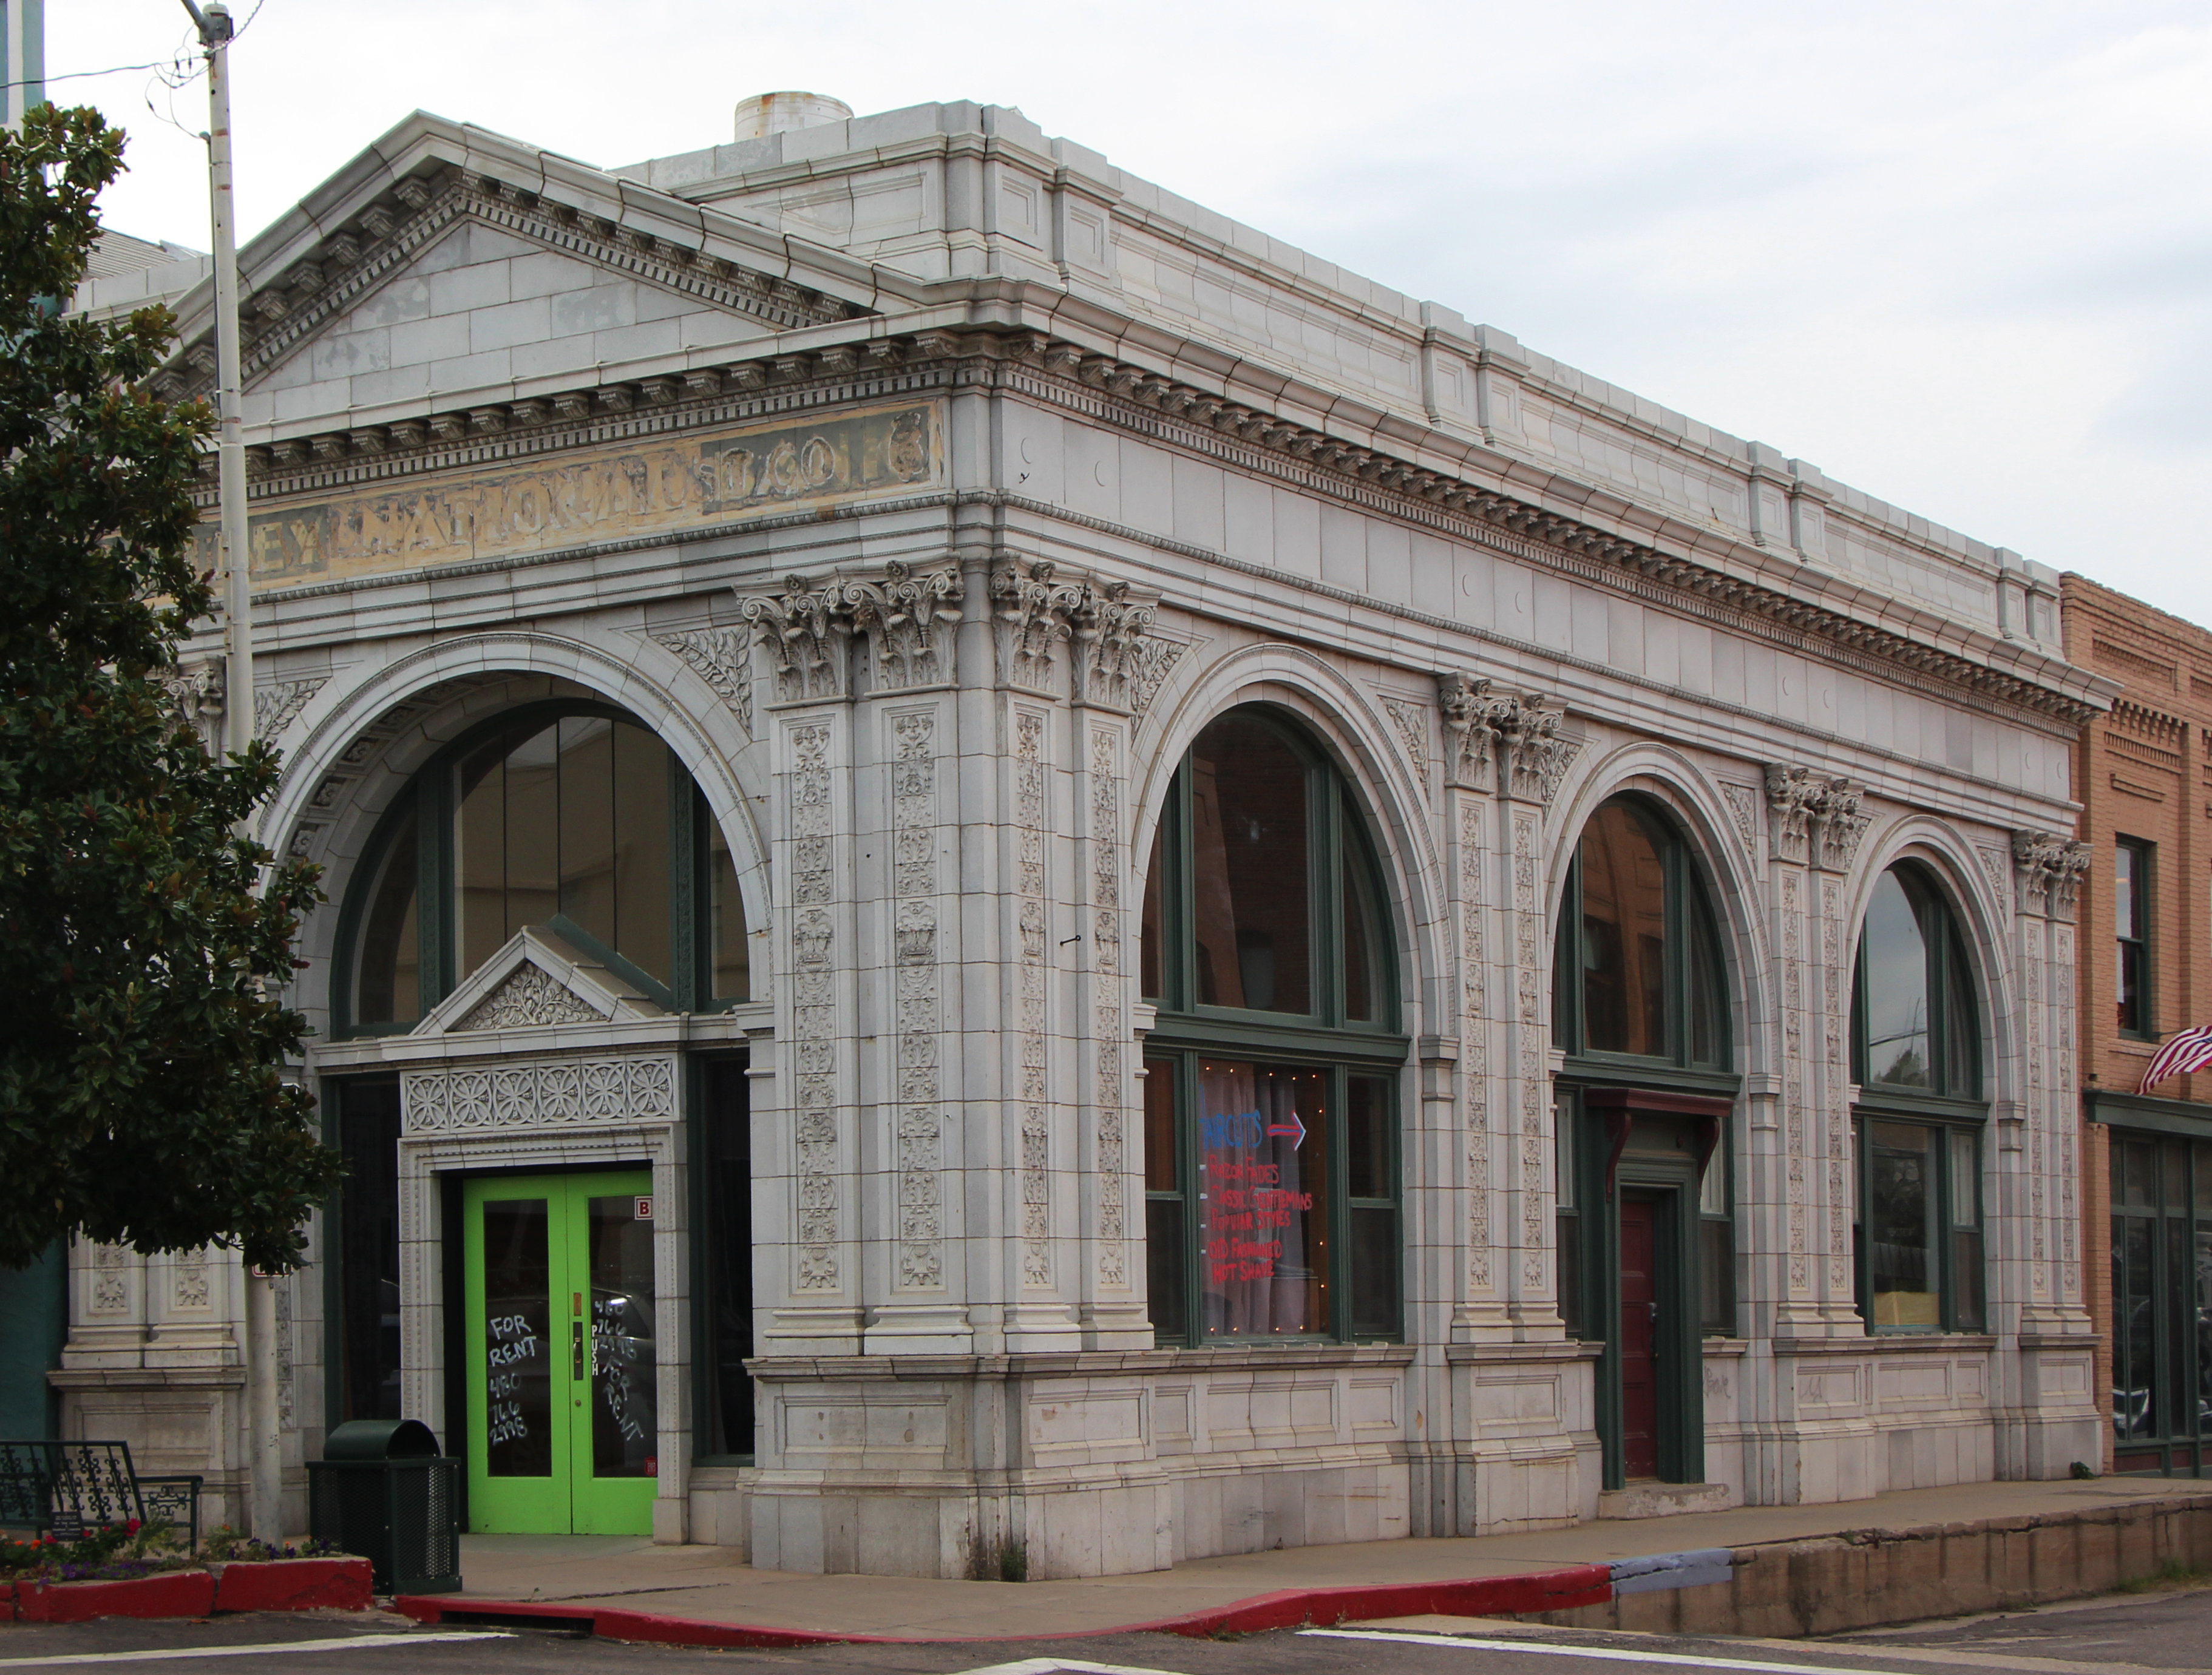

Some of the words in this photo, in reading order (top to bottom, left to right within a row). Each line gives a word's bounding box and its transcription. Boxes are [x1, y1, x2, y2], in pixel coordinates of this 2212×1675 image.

[1209, 1154, 1244, 1180] RAZOR
[1246, 1156, 1280, 1184] FADES
[640, 1202, 649, 1214] B
[1211, 1208, 1254, 1231] POPULAR
[1257, 1210, 1291, 1230] STYLES
[1209, 1237, 1229, 1259] OLD
[1231, 1237, 1283, 1259] FASHIONED
[1212, 1262, 1237, 1285] HOT
[1239, 1260, 1274, 1281] SHAVE
[490, 1315, 532, 1340] FOR
[489, 1336, 537, 1367] RENT
[490, 1373, 521, 1398] 480
[489, 1401, 520, 1424] 766
[489, 1416, 528, 1446] 2998
